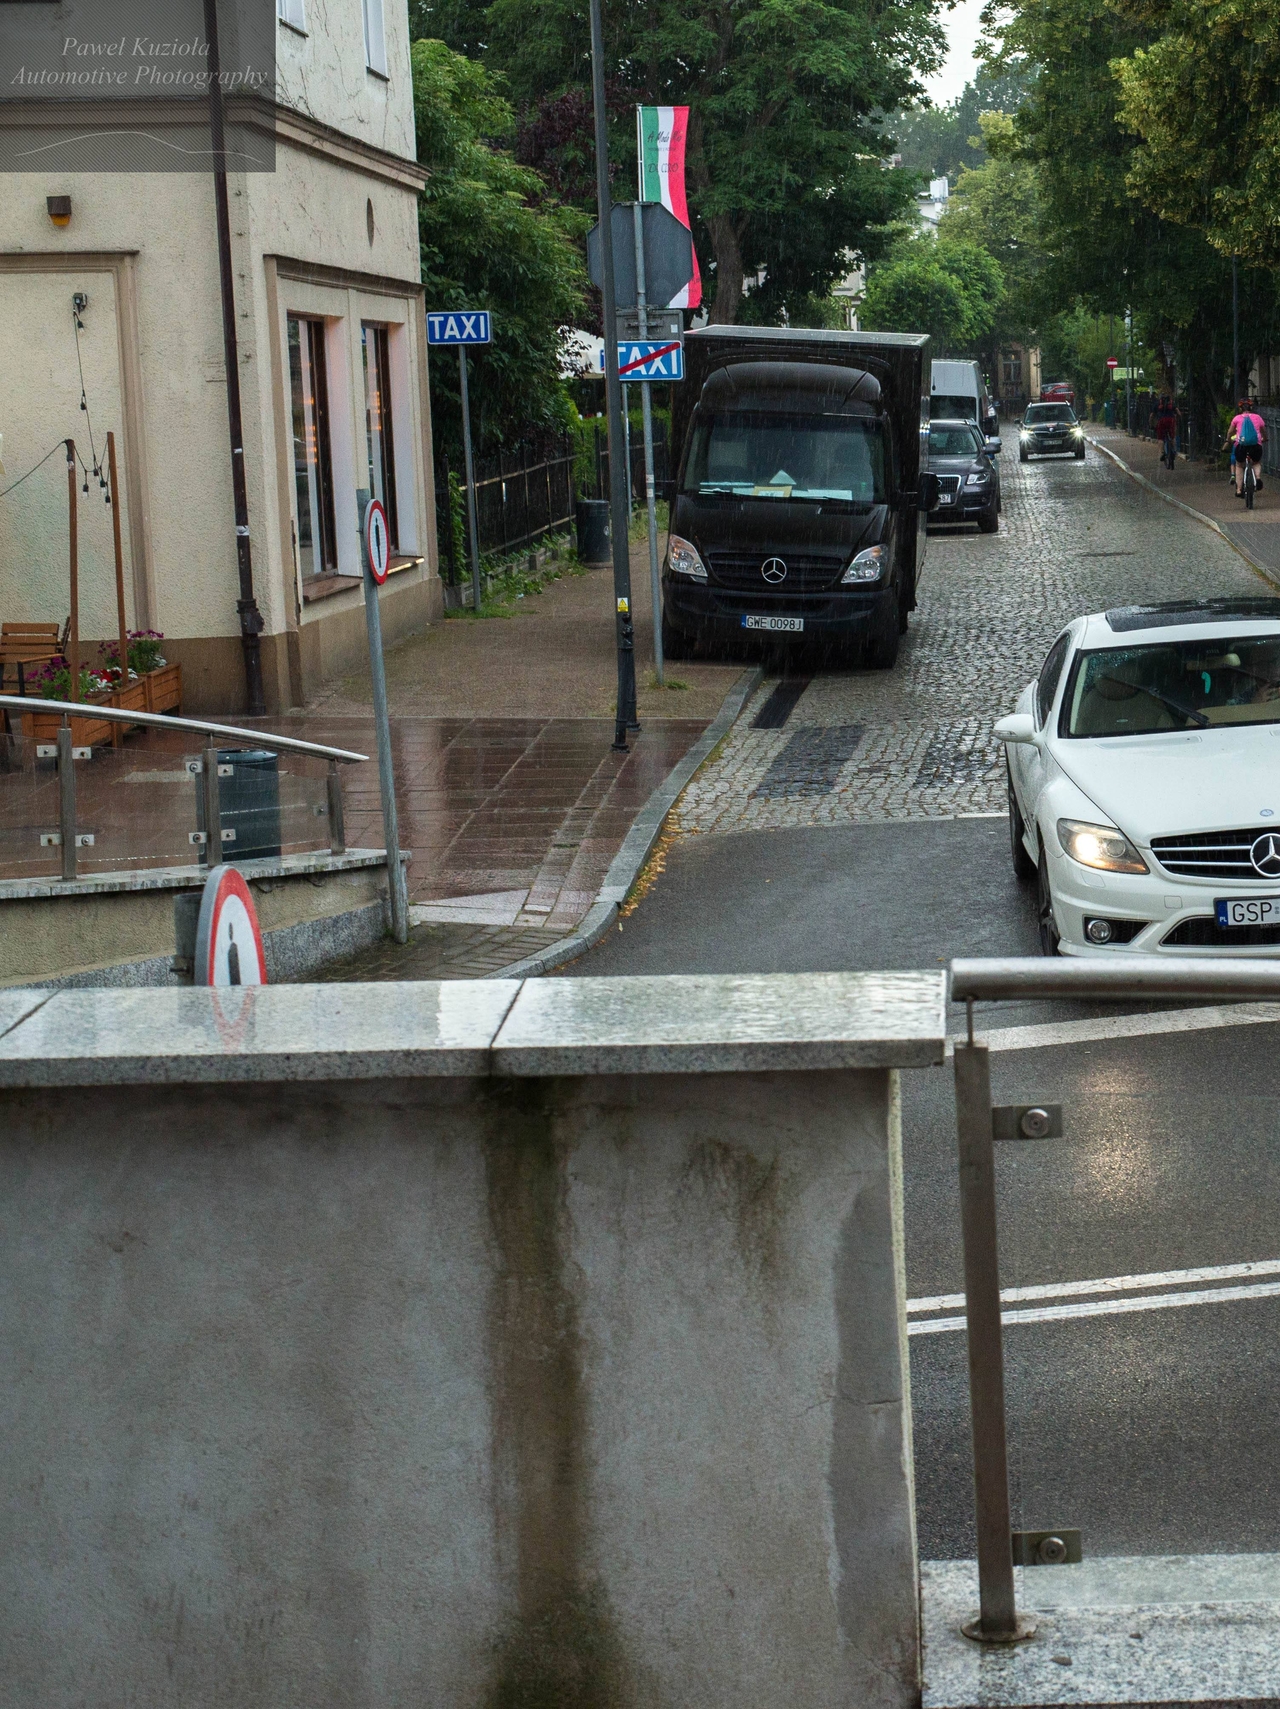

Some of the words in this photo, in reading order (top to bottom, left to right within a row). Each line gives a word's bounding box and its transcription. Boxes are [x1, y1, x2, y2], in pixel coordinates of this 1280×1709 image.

[428, 315, 489, 340] TAXI
[746, 616, 767, 628] GWE
[770, 618, 801, 630] 0098J
[1232, 902, 1272, 922] GSP
